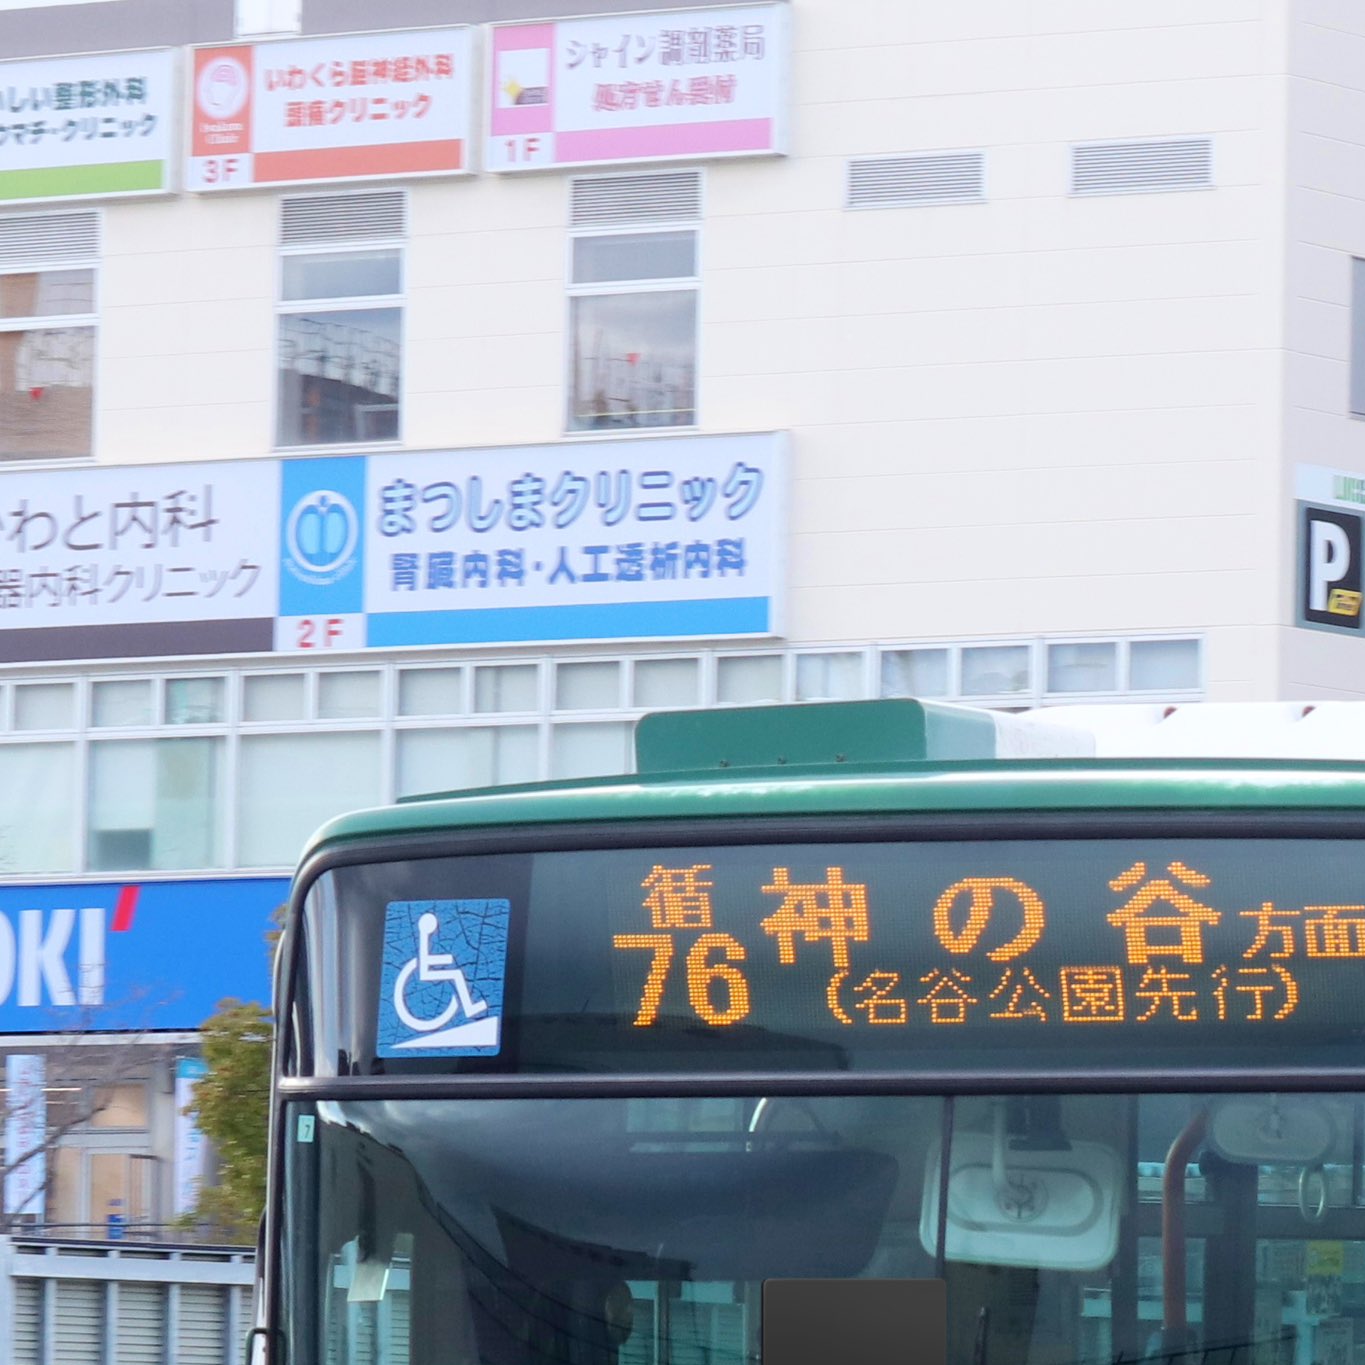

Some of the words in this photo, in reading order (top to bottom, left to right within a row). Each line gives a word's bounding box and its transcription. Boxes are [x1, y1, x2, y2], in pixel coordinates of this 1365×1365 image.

[0, 76, 148, 113] しい整形外科
[202, 157, 239, 183] 3F
[505, 137, 540, 162] 1F
[0, 484, 220, 553] わと内科
[378, 461, 765, 538] まつしまクリニック
[1309, 519, 1351, 612] P
[296, 617, 344, 649] 2F
[613, 934, 750, 1026] 76
